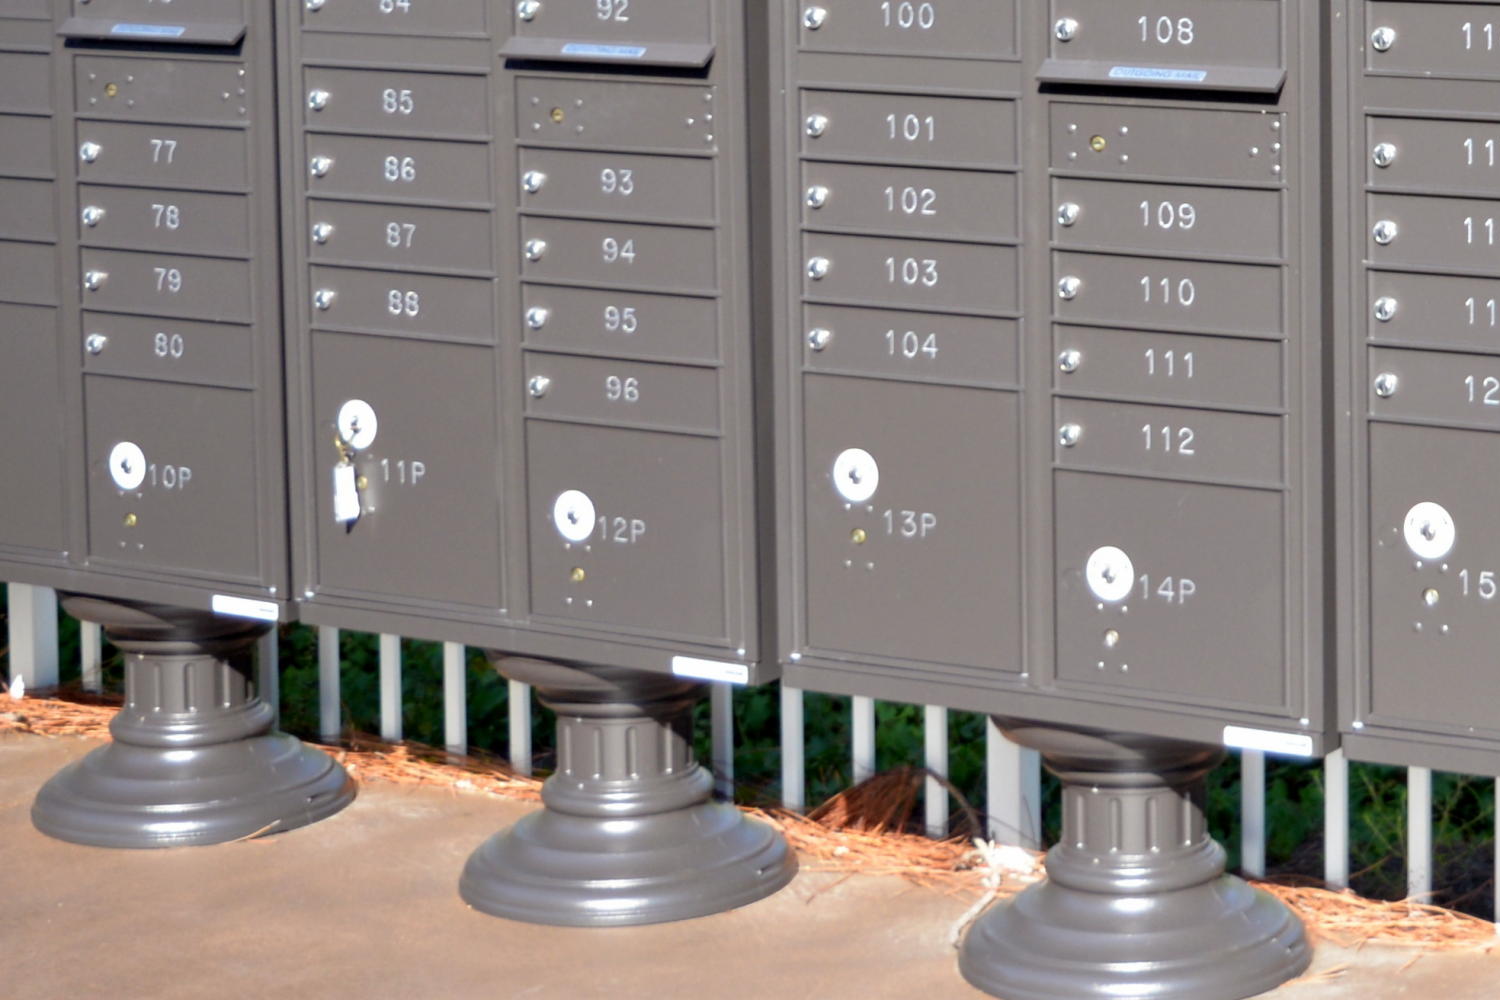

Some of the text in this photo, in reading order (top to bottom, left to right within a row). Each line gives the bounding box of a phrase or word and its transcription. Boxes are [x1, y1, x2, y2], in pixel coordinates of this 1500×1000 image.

[880, 1, 935, 30] 100
[1137, 15, 1194, 46] 108
[382, 88, 414, 115] 85
[885, 113, 935, 142] 101
[149, 138, 178, 164] 77
[384, 155, 416, 182] 86
[600, 167, 634, 196] 93
[884, 185, 937, 216] 102
[1139, 200, 1196, 230] 109
[151, 203, 180, 230] 78
[385, 221, 417, 248] 87
[601, 237, 637, 264] 94
[153, 267, 182, 293] 79
[885, 256, 939, 288] 103
[387, 289, 420, 318] 88
[1140, 275, 1196, 307] 110
[603, 305, 638, 334] 95
[154, 332, 184, 359] 80
[885, 329, 939, 359] 104
[1144, 348, 1194, 379] 111
[605, 375, 640, 403] 96
[1141, 423, 1195, 456] 112
[149, 463, 191, 489] 10P
[380, 458, 426, 485] 11P
[598, 516, 646, 543] 12P
[883, 509, 937, 538] 13P
[1139, 573, 1196, 605] 14P
